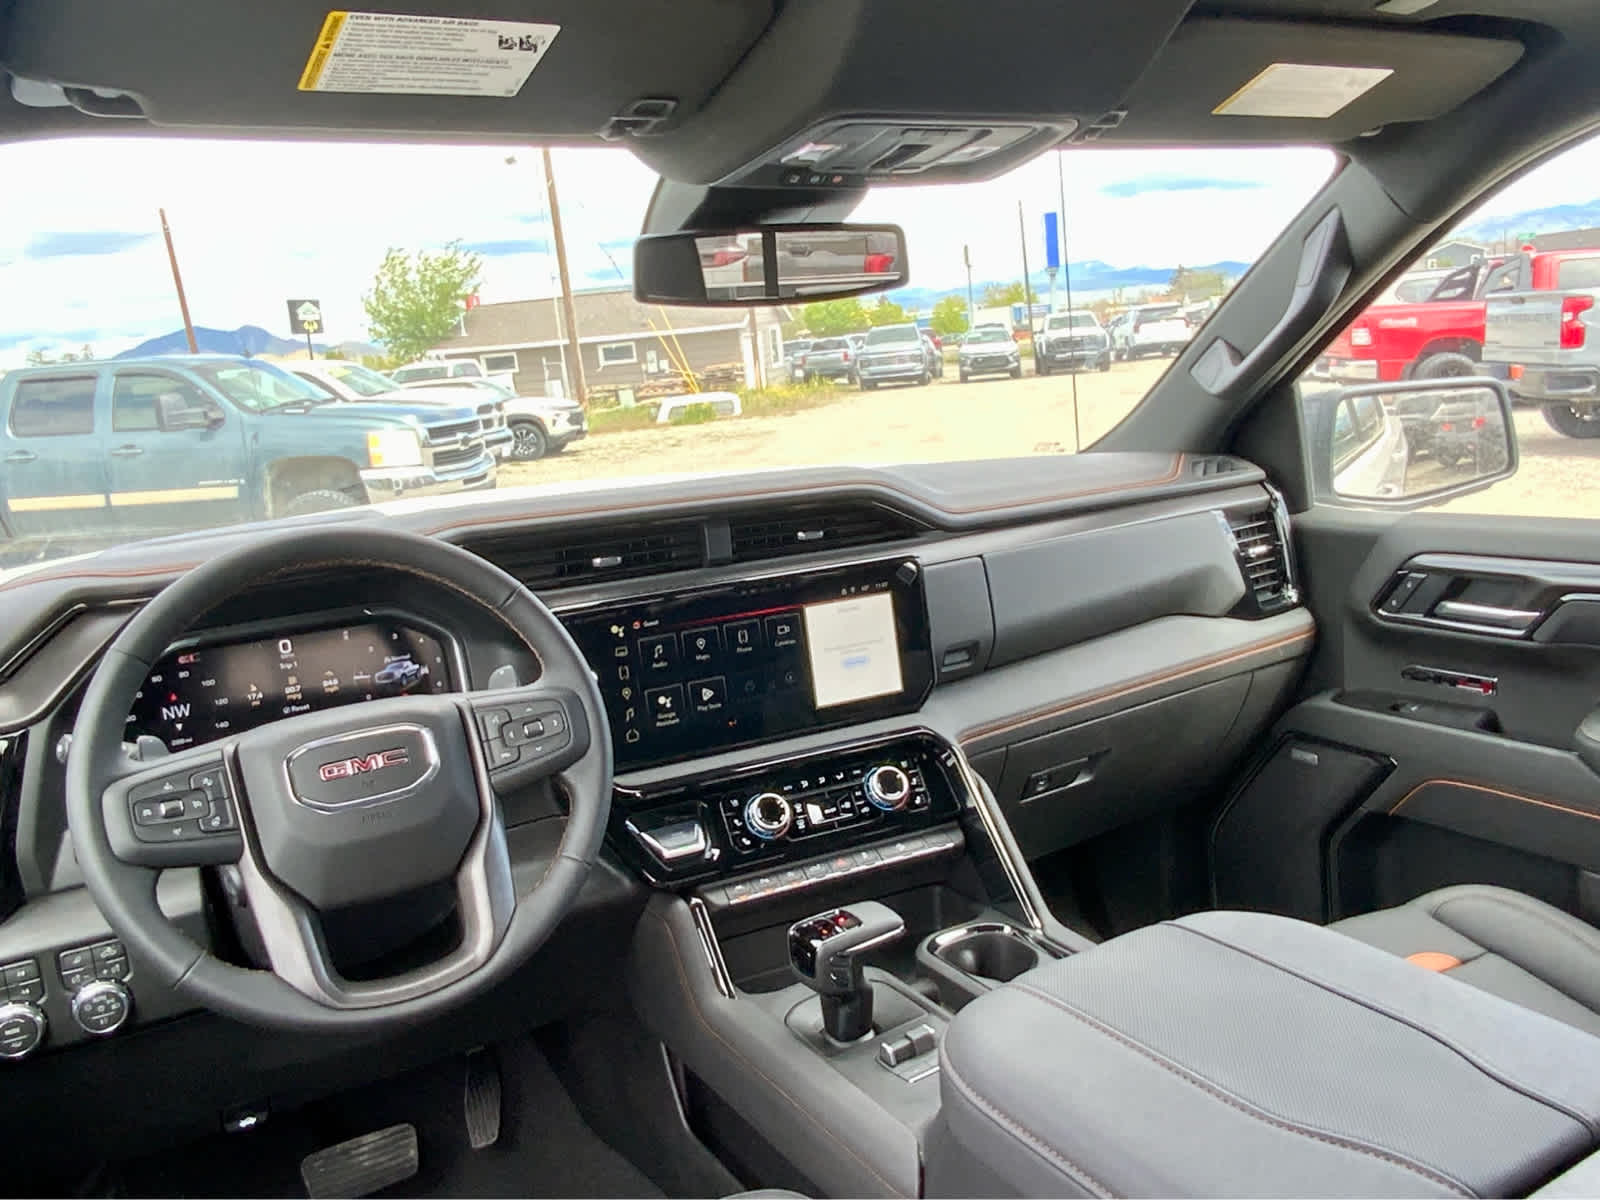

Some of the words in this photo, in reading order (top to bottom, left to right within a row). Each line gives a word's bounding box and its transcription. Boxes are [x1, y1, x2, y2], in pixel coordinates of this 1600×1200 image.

[278, 639, 292, 654] 0
[161, 703, 191, 720] NW
[319, 747, 409, 782] GMC
